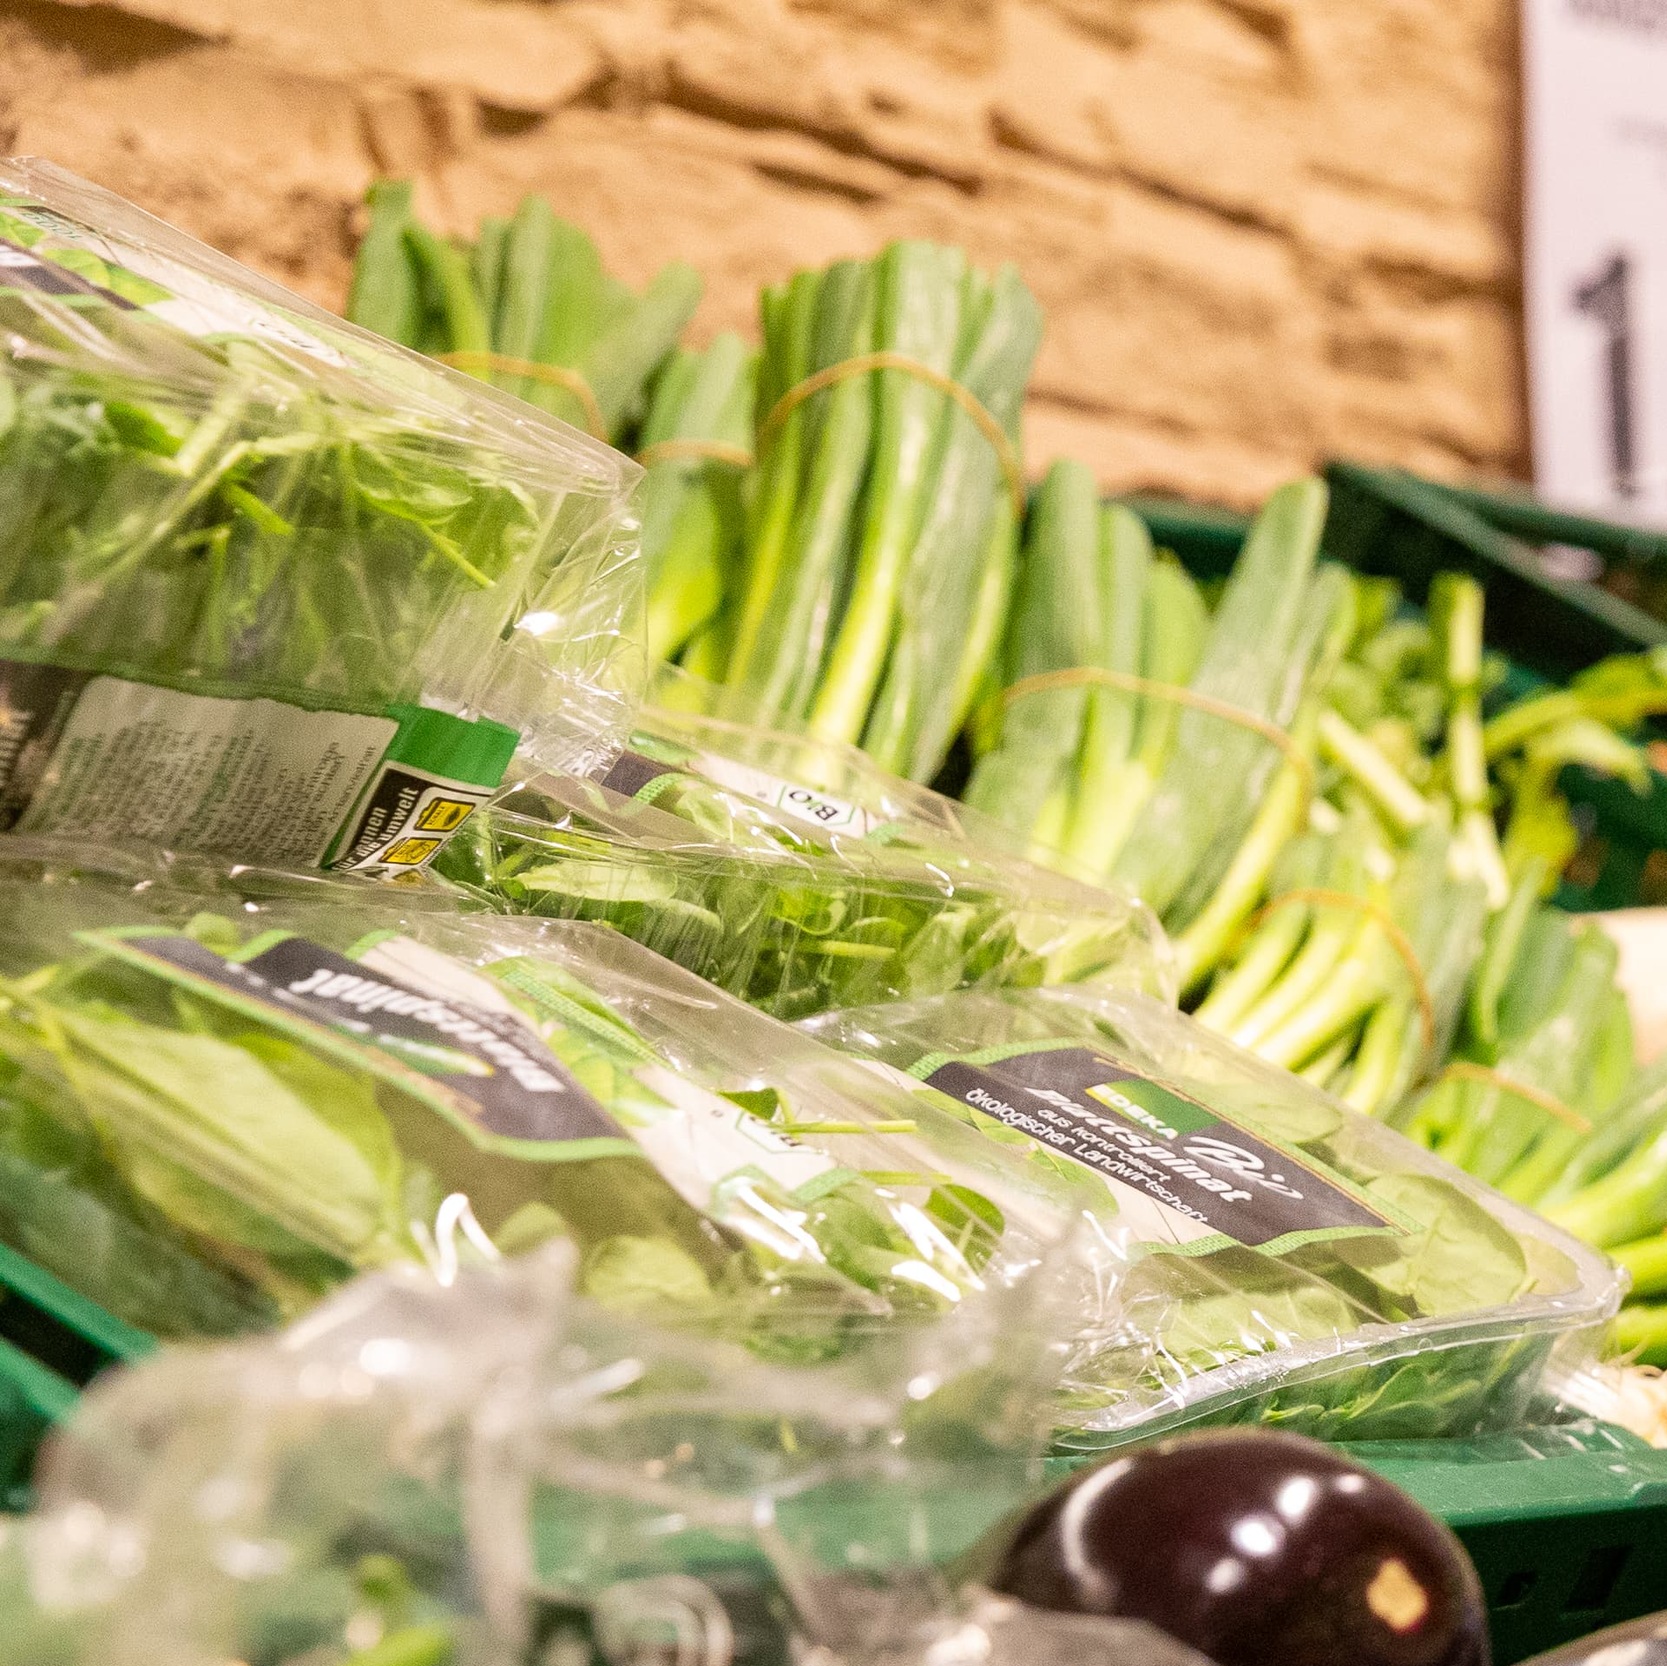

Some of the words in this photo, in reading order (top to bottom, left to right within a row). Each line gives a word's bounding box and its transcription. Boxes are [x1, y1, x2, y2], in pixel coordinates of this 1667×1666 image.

[1568, 248, 1641, 499] 1
[288, 967, 567, 1093] Blattspinat
[965, 1086, 1077, 1146] ökologischer
[1072, 1142, 1209, 1223] Landwirtschaft
[1023, 1087, 1253, 1203] Blattspinat
[1037, 1108, 1073, 1129] aus
[1071, 1125, 1172, 1184] kontrolliert
[1091, 1083, 1179, 1141] EDEKA
[1183, 1136, 1304, 1200] Bio
